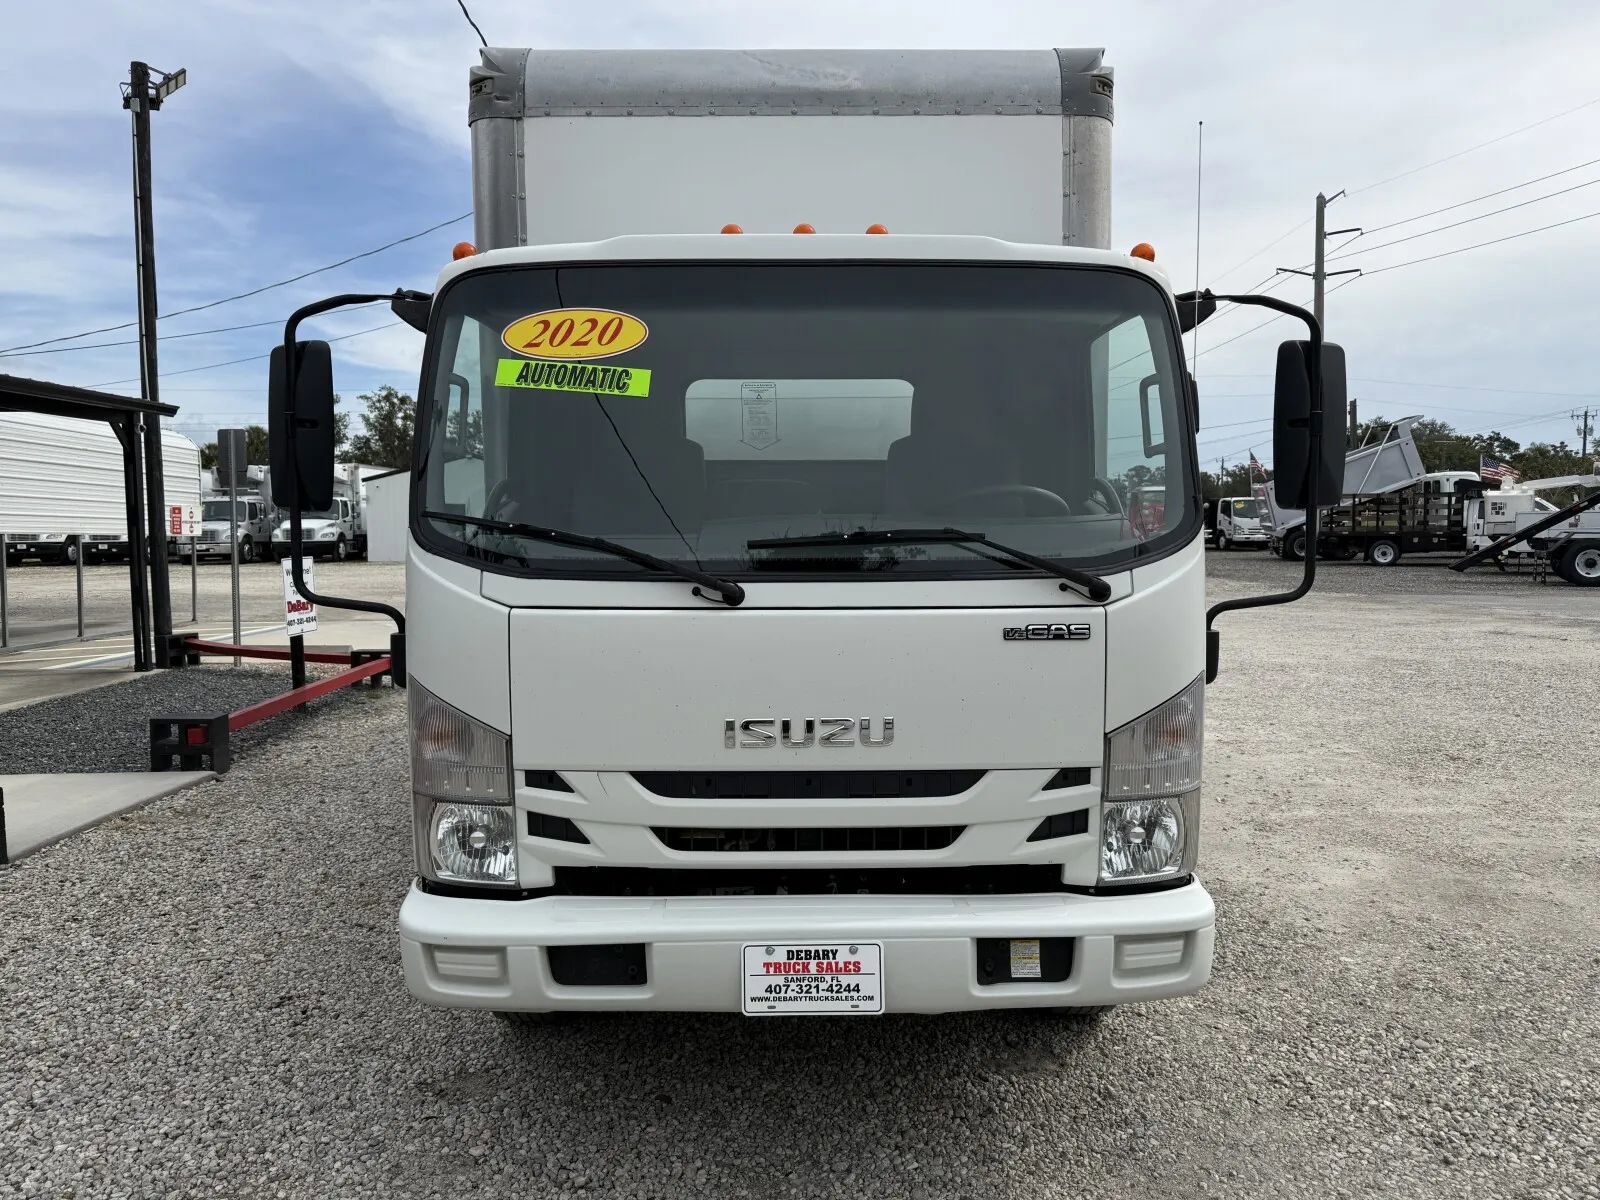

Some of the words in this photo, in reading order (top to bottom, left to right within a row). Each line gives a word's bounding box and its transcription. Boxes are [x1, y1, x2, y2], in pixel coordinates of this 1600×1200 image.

[522, 316, 624, 348] 2020
[516, 361, 632, 393] AUTOMATIC
[724, 717, 895, 748] ISUZU
[786, 949, 839, 961] DEBARY
[763, 962, 811, 974] TRUCK
[816, 961, 861, 973] SALES
[783, 976, 828, 984] SANFORD,
[765, 983, 860, 994] 407-321-4244
[750, 995, 874, 1003] WWW.DEBARYTRUCKSALES.COM
